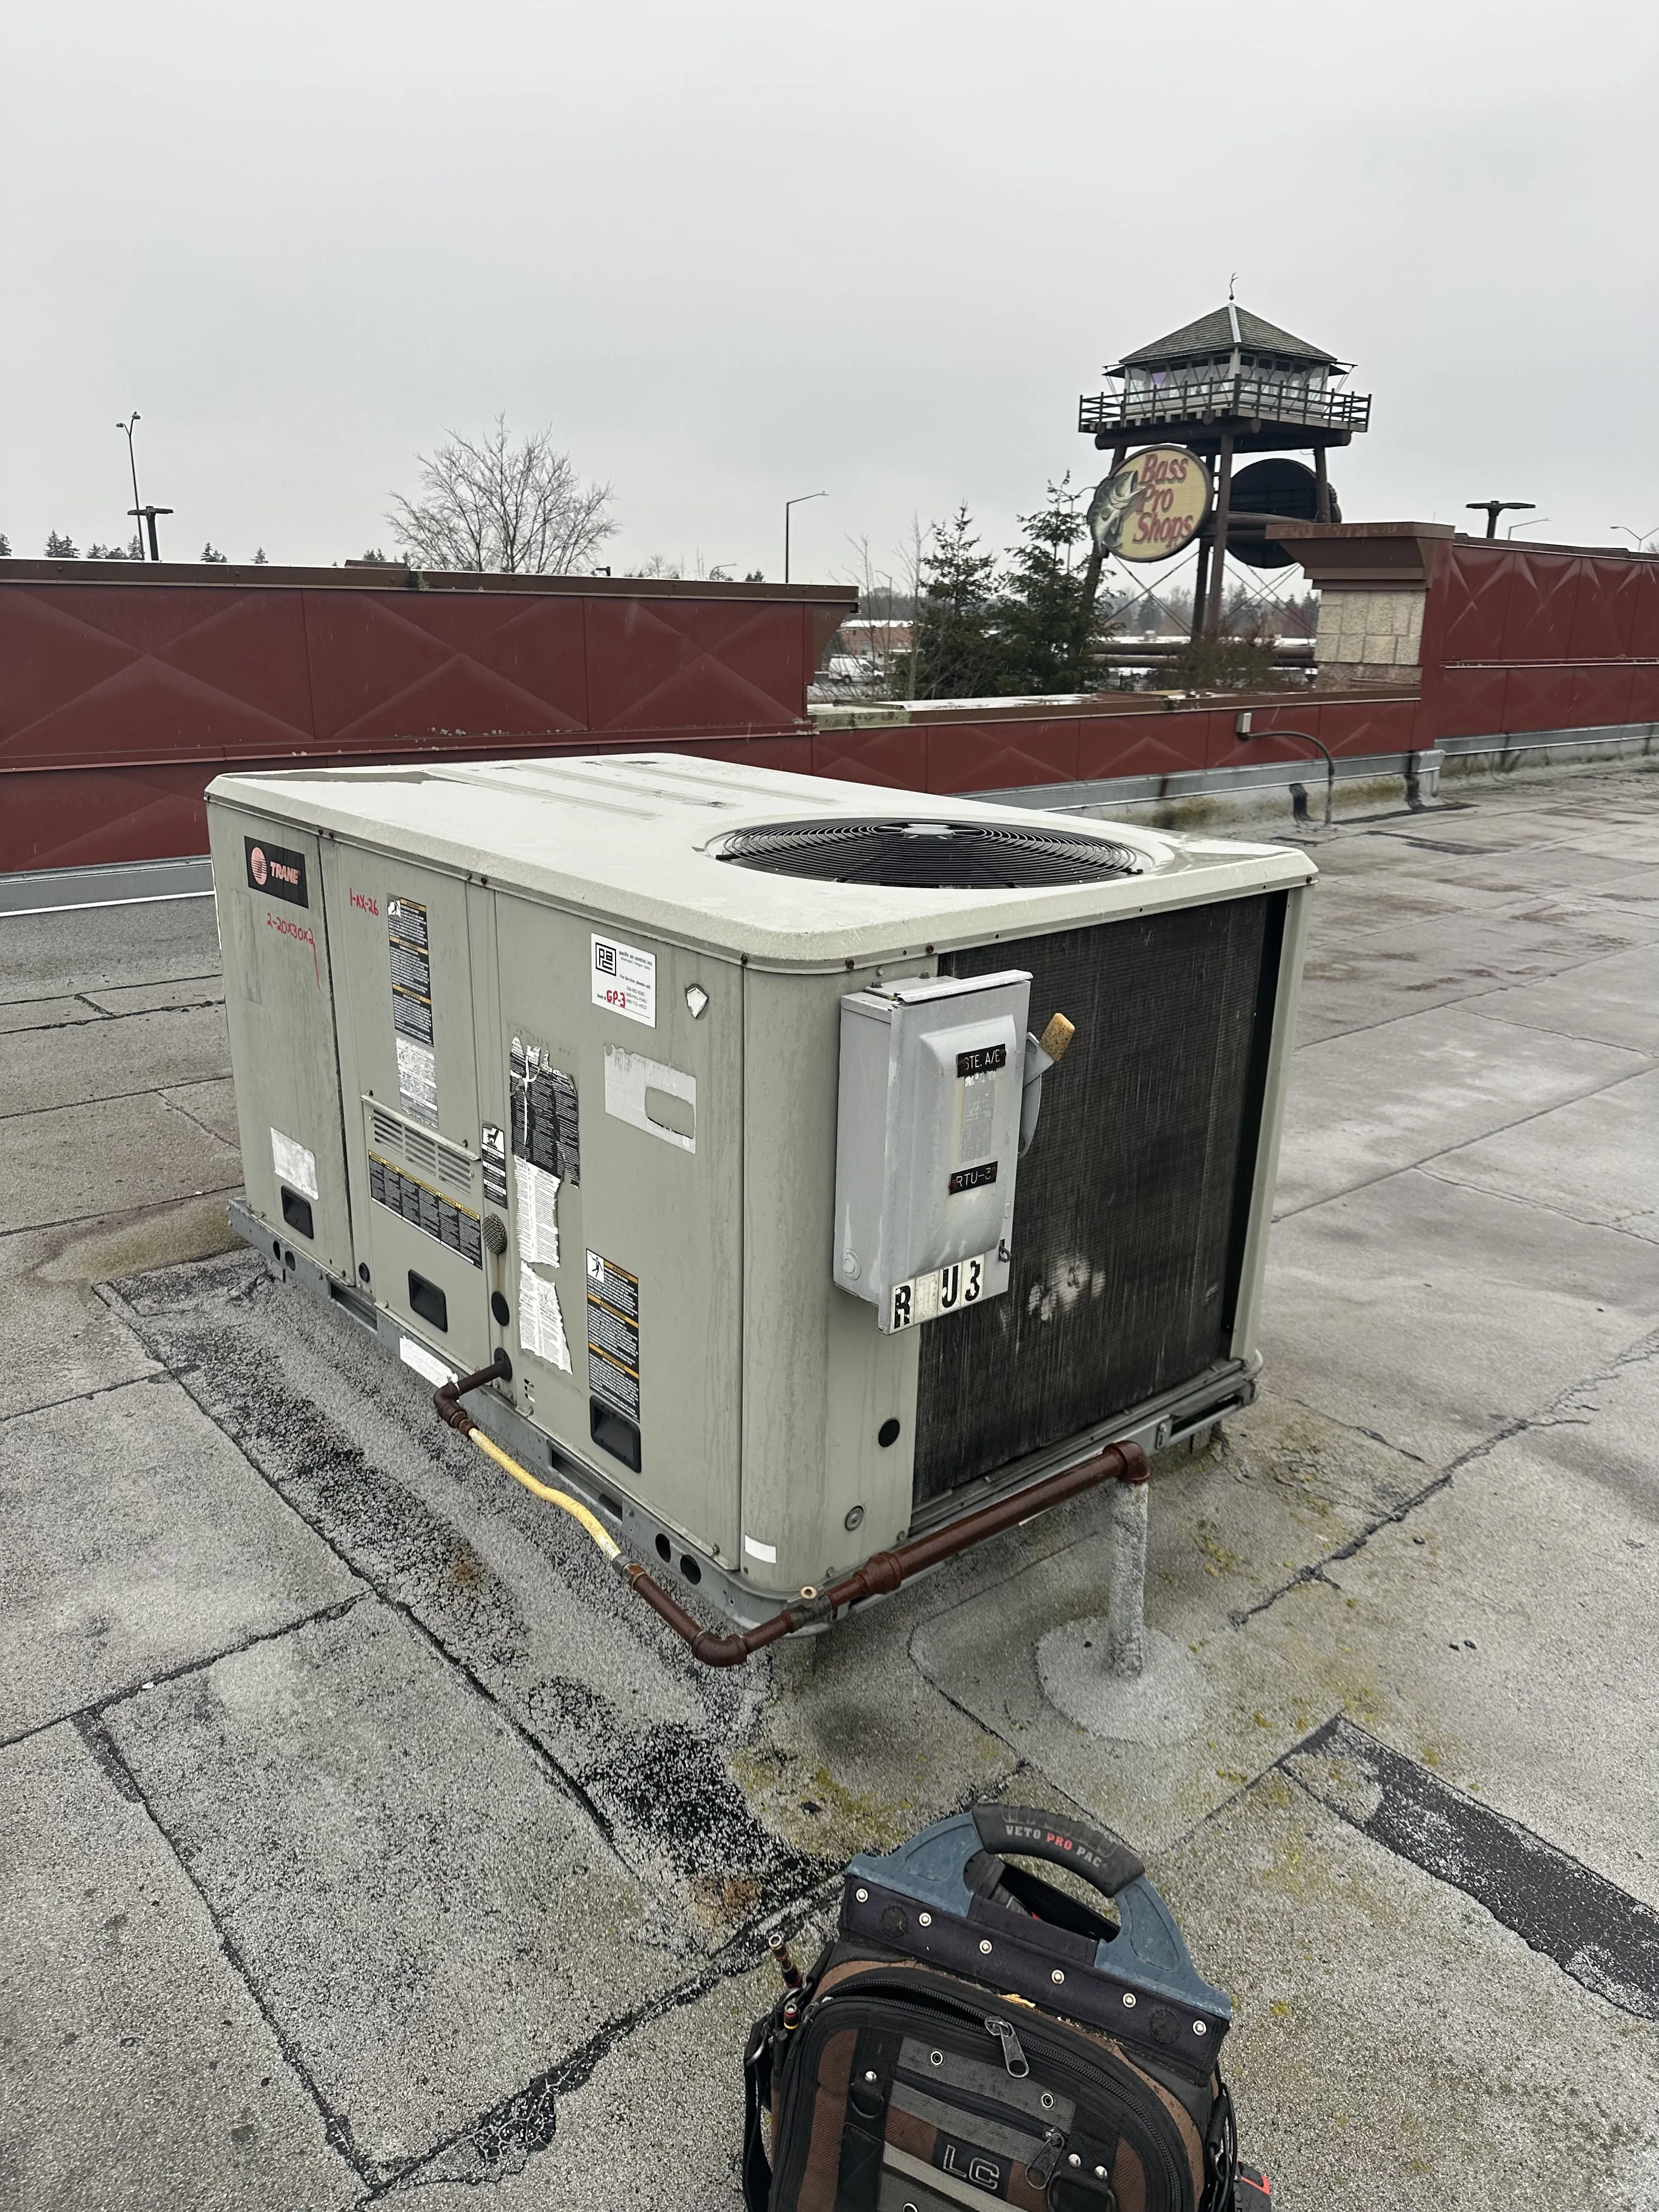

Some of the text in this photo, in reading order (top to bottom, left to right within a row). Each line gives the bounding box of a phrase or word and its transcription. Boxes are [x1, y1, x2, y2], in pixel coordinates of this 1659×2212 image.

[1139, 454, 1189, 486] Bass
[1137, 485, 1174, 512] Pro
[1133, 511, 1194, 548] Shops
[270, 861, 299, 885] TRANE
[956, 1167, 991, 1187] RTU-3
[1005, 1825, 1102, 1868] VETO PRO PAC
[943, 2144, 1000, 2190] LC
